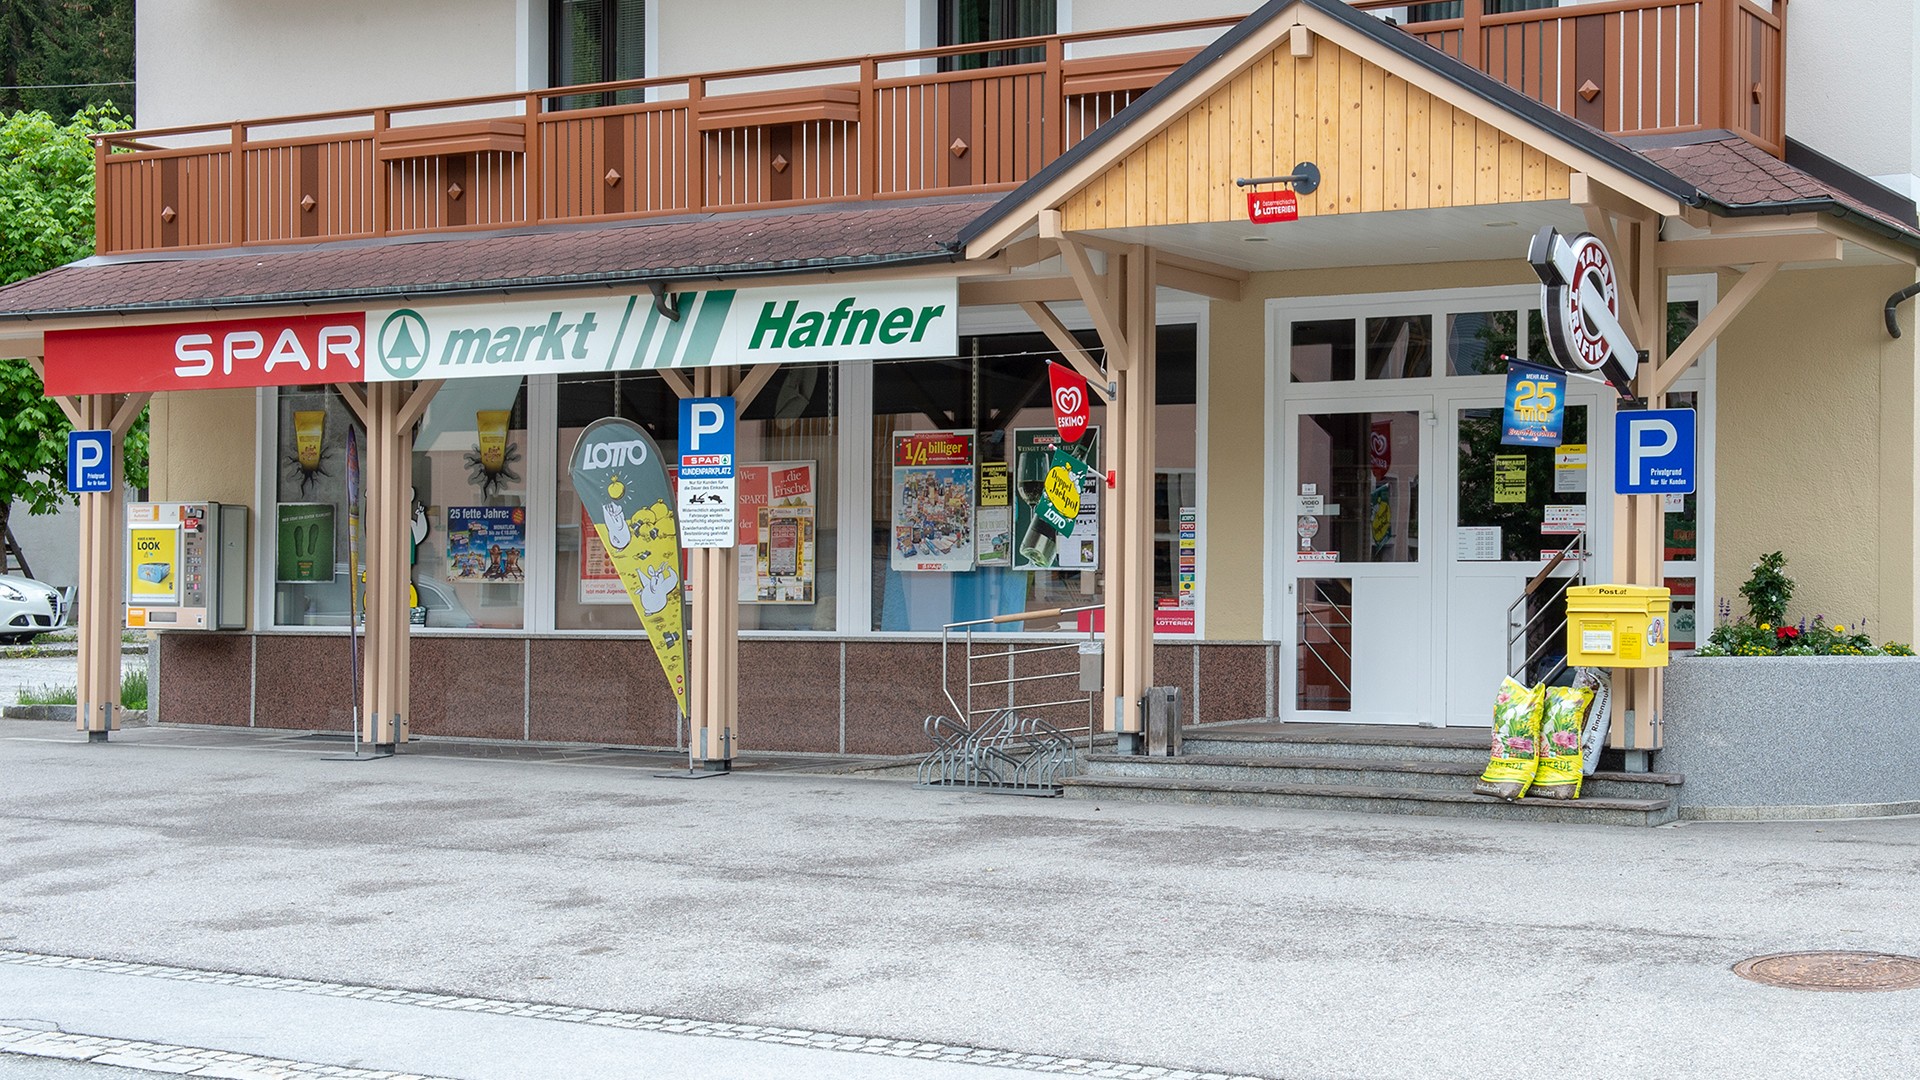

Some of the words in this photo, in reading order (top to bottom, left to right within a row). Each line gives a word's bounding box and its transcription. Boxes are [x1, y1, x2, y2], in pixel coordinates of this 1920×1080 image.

[1263, 206, 1296, 215] LOTTERIEN
[1579, 247, 1614, 300] TABAK
[1571, 288, 1604, 362] TRAFIK
[175, 326, 361, 377] SPAR
[440, 311, 598, 365] markt
[748, 297, 945, 350] Hafner
[1514, 381, 1556, 412] 25
[691, 403, 725, 451] P
[1058, 415, 1084, 427] ESKIMO
[77, 439, 103, 488] P
[583, 440, 647, 470] LOTTO
[691, 457, 720, 465] SPAR
[906, 442, 927, 466] 1/4
[929, 441, 962, 456] billiger
[1629, 419, 1678, 486] P
[740, 471, 756, 480] Wer
[1051, 470, 1072, 492] Doppel
[1651, 468, 1682, 477] Privatgrund
[774, 483, 810, 497] Frische.
[1050, 482, 1078, 511] Jackpot
[450, 508, 461, 519] 25
[462, 508, 481, 519] fette
[482, 508, 509, 519] Jahre:
[740, 519, 753, 528] der
[1044, 508, 1066, 529] LOTTO
[138, 541, 160, 550] LOOK
